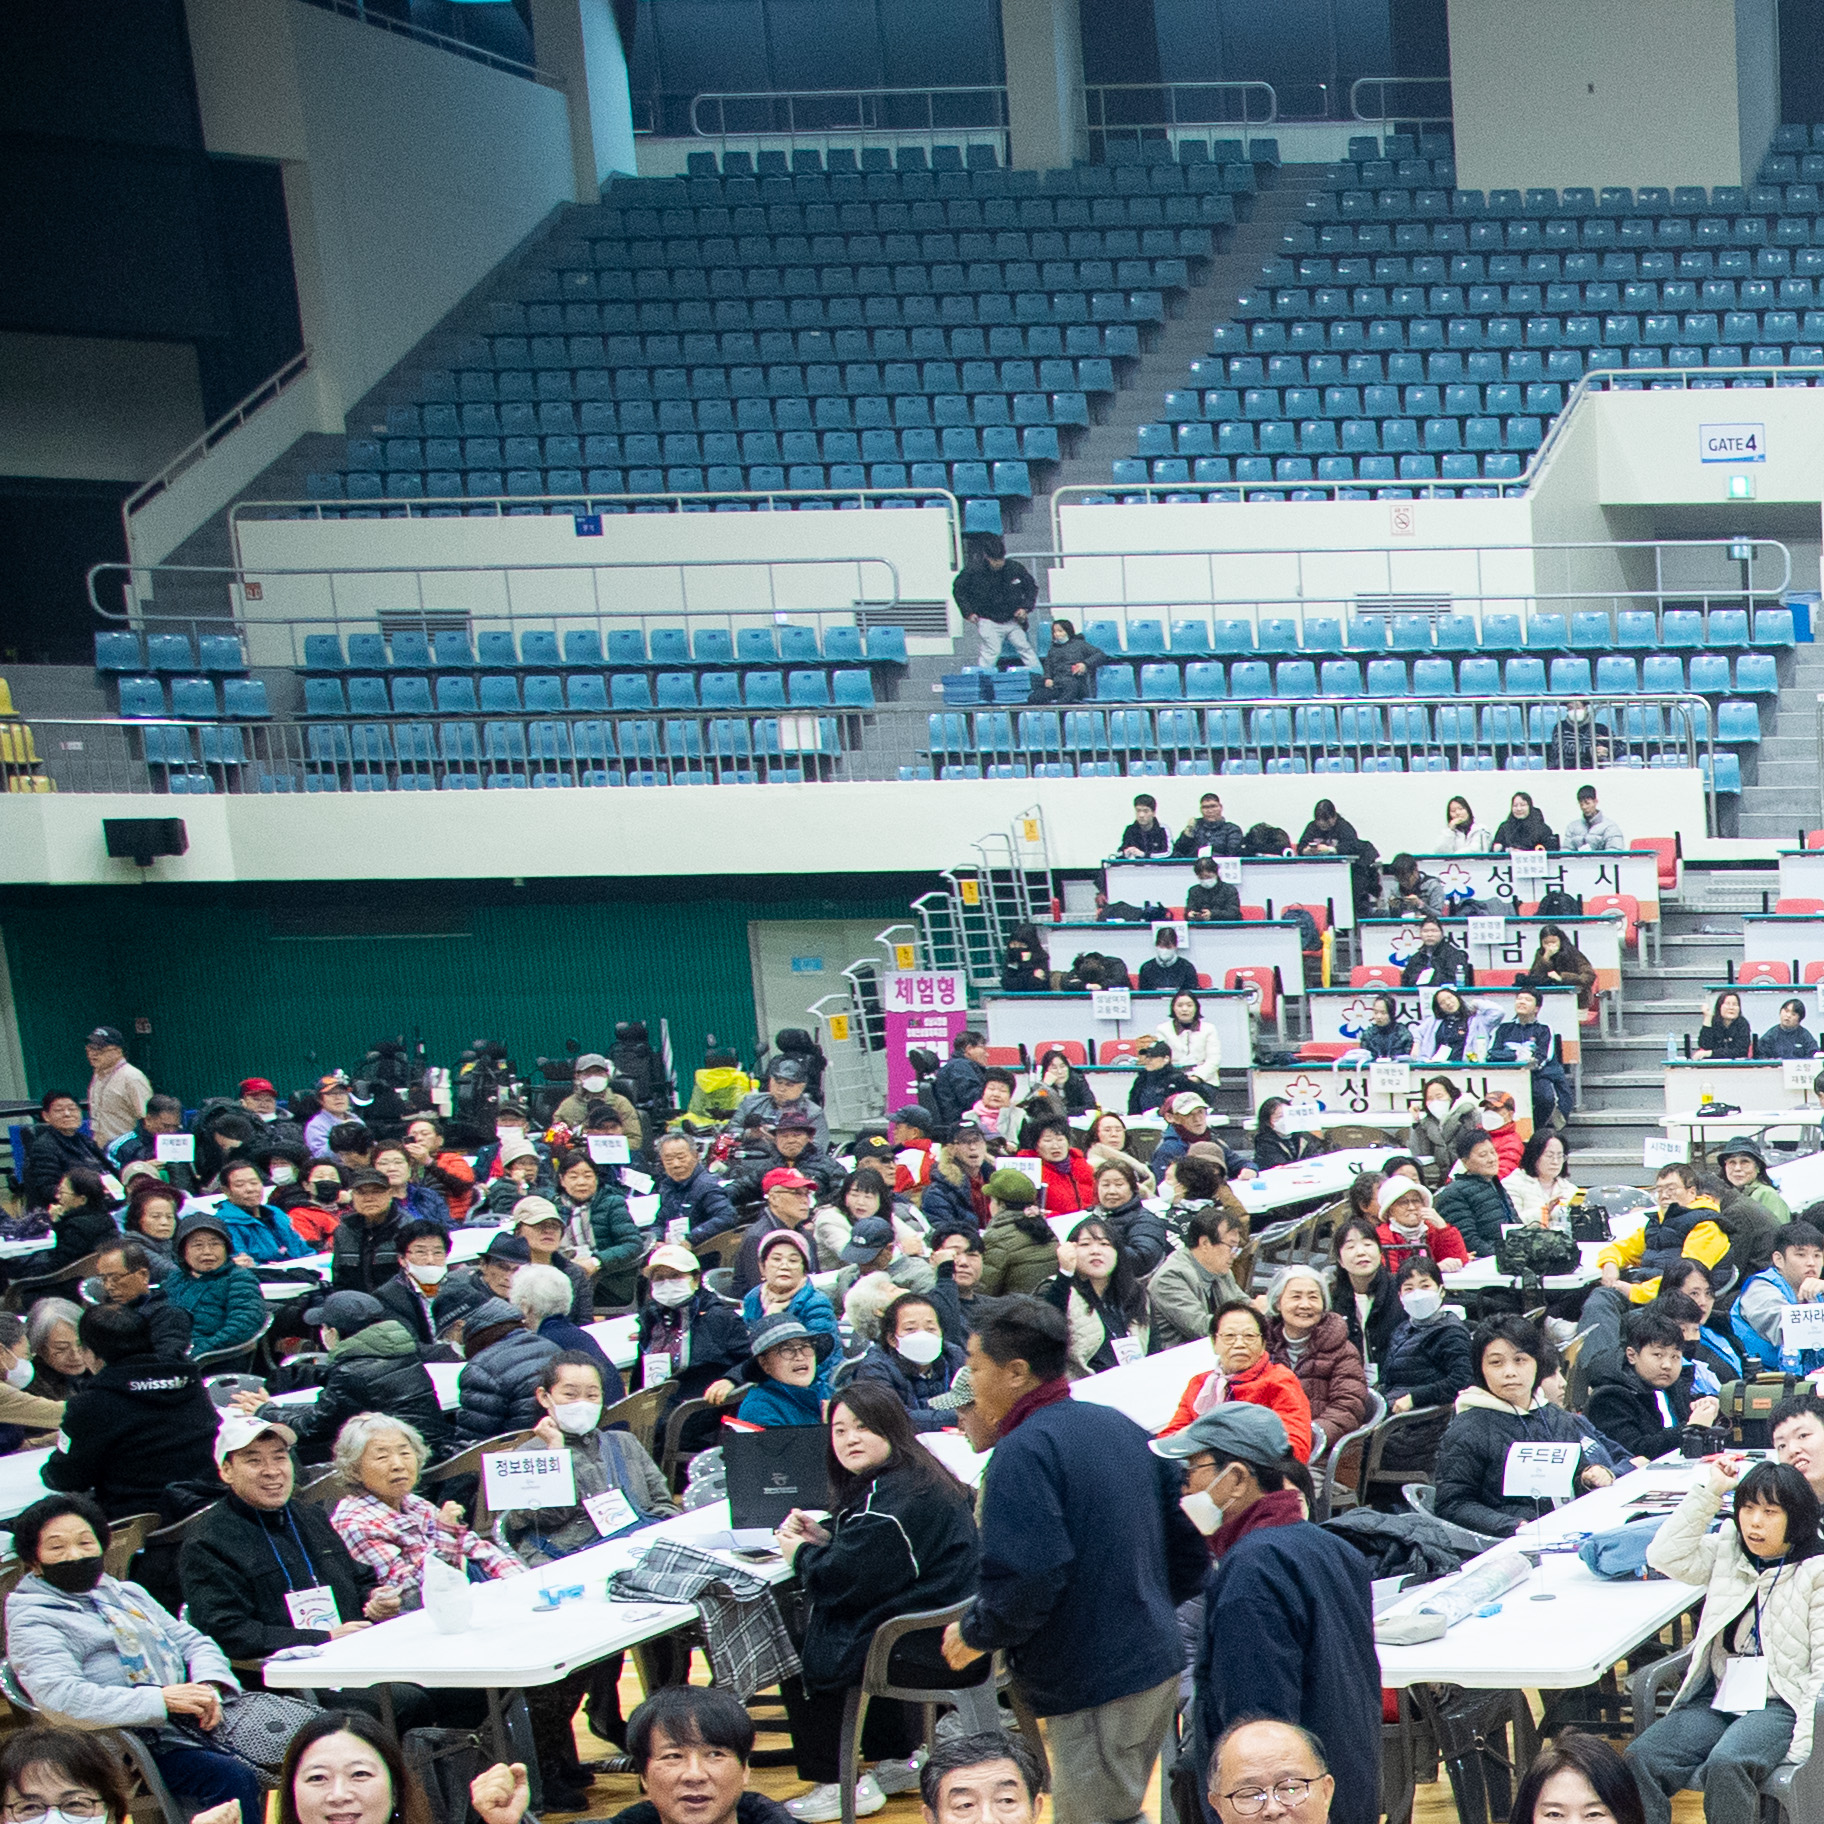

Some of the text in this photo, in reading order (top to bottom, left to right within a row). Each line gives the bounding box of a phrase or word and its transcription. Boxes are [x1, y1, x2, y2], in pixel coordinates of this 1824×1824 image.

[895, 976, 955, 1006] 체험형
[495, 1456, 561, 1477] 정보화협회
[1517, 1448, 1568, 1464] 두드림
